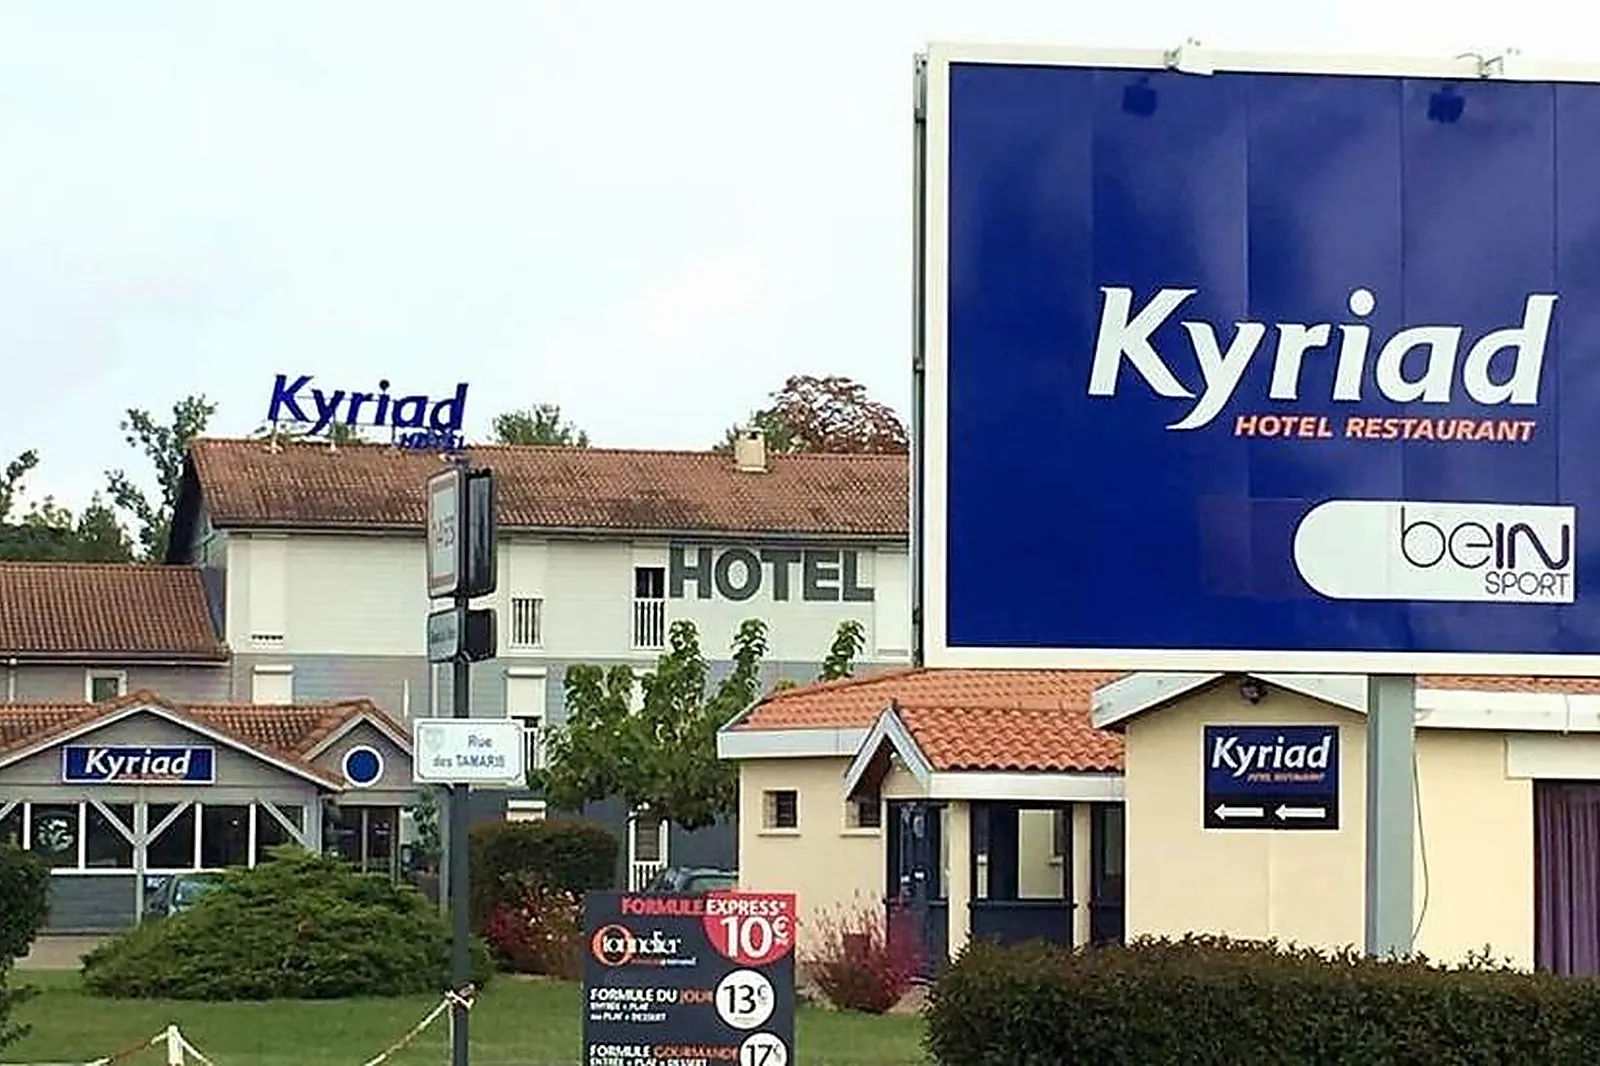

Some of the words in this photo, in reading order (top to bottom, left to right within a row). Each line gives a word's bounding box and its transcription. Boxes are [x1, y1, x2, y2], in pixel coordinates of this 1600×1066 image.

[1087, 286, 1558, 431] Kyriad
[267, 373, 469, 436] Kyriad
[1234, 415, 1334, 438] HOTEL
[1345, 417, 1537, 442] RESTAURANT
[668, 545, 876, 603] HOTEL
[1484, 571, 1571, 597] SPORT
[467, 734, 493, 748] Rue
[84, 748, 192, 781] Kyriad
[433, 754, 453, 768] des
[1211, 735, 1333, 778] Kyriad
[622, 898, 704, 915] FORMULE
[656, 988, 679, 1003] DU
